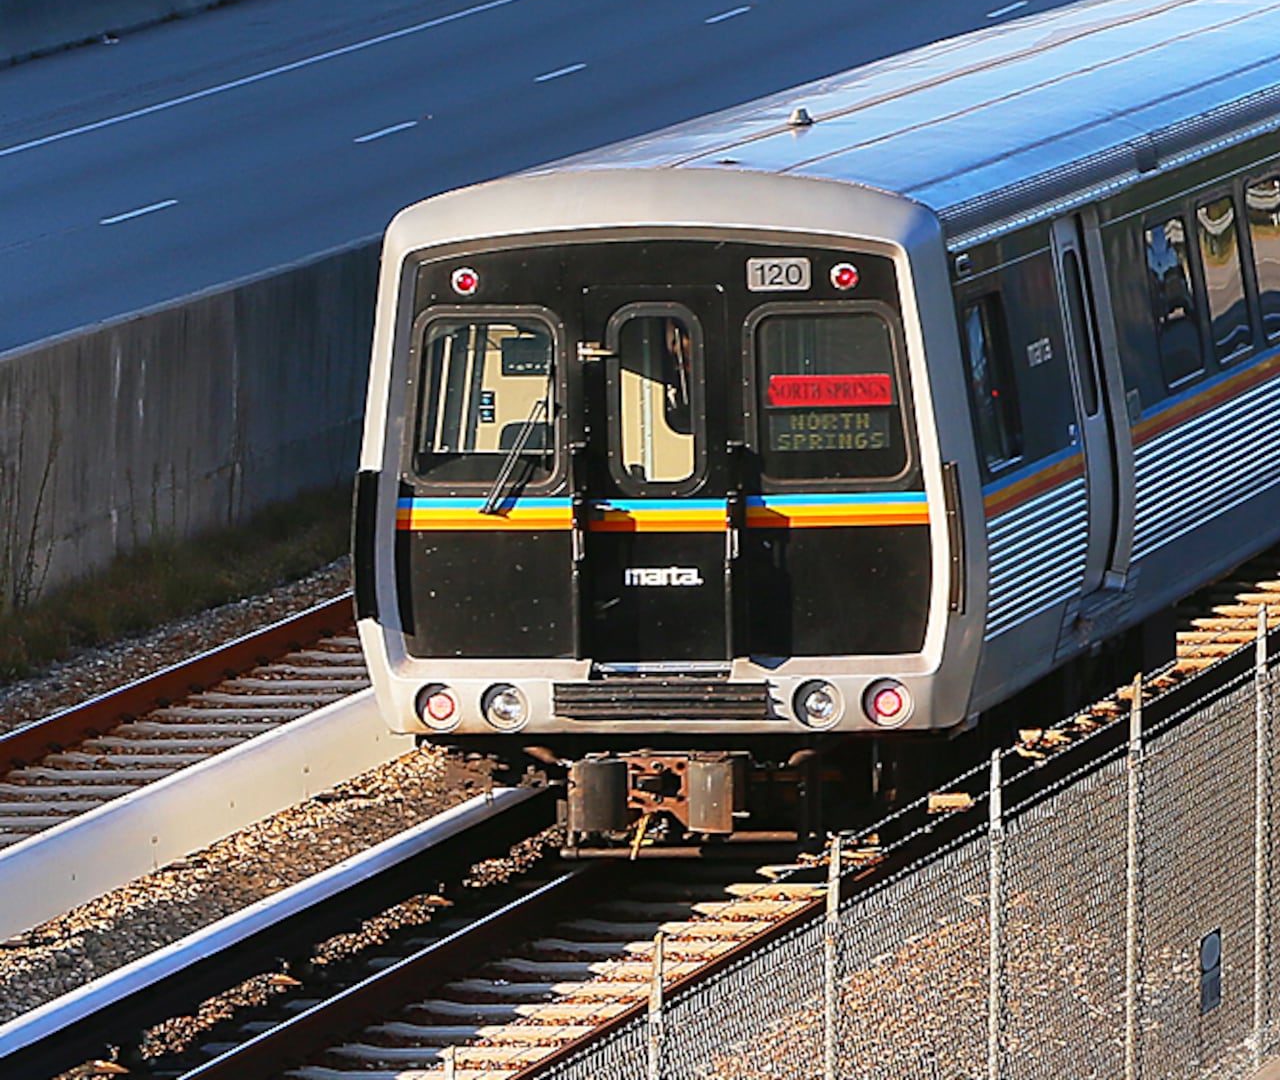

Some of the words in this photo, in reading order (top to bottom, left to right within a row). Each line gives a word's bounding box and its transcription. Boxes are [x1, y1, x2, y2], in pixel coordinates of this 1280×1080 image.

[755, 264, 803, 286] 120
[771, 381, 821, 400] NORTH
[825, 380, 887, 399] SPRINGS
[790, 411, 870, 431] NORTH
[777, 431, 885, 450] SPRINGS
